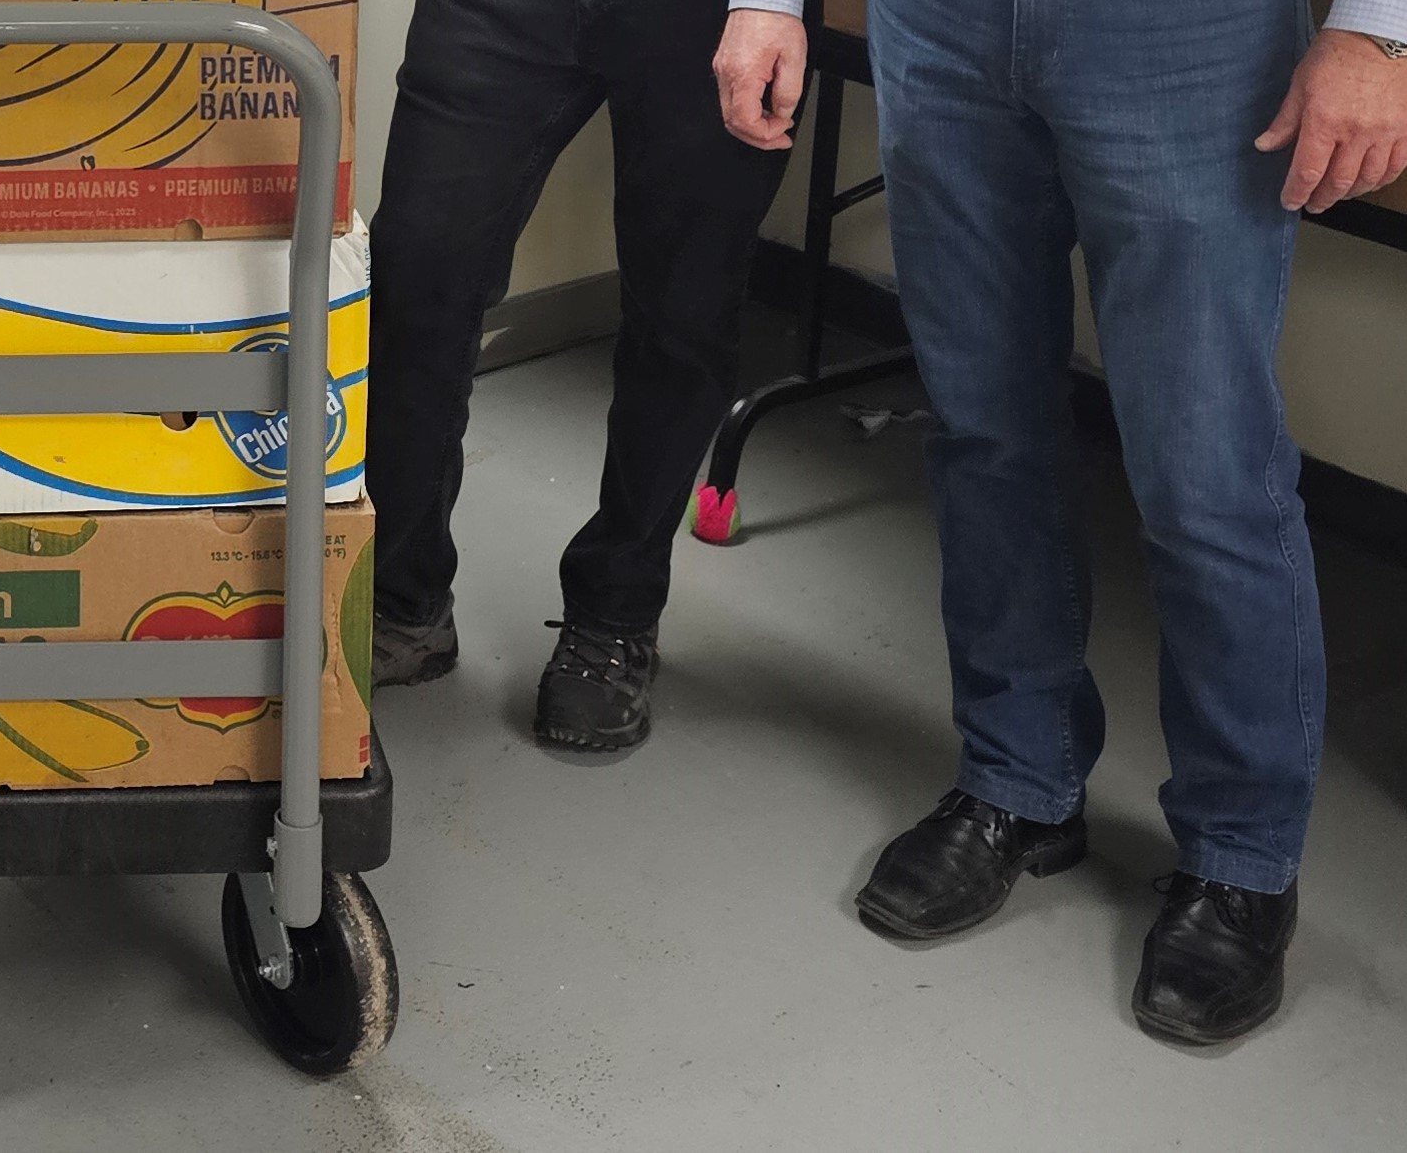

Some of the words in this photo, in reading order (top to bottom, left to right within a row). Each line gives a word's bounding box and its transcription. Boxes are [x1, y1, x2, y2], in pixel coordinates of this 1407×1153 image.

[200, 54, 340, 85] PREM
[200, 91, 301, 120] BANAN
[54, 180, 139, 199] BANANAS
[165, 178, 247, 197] PREMIUM
[252, 176, 298, 194] BANA
[31, 208, 52, 219] Food
[333, 535, 346, 545] AT
[210, 552, 230, 562] 13.3
